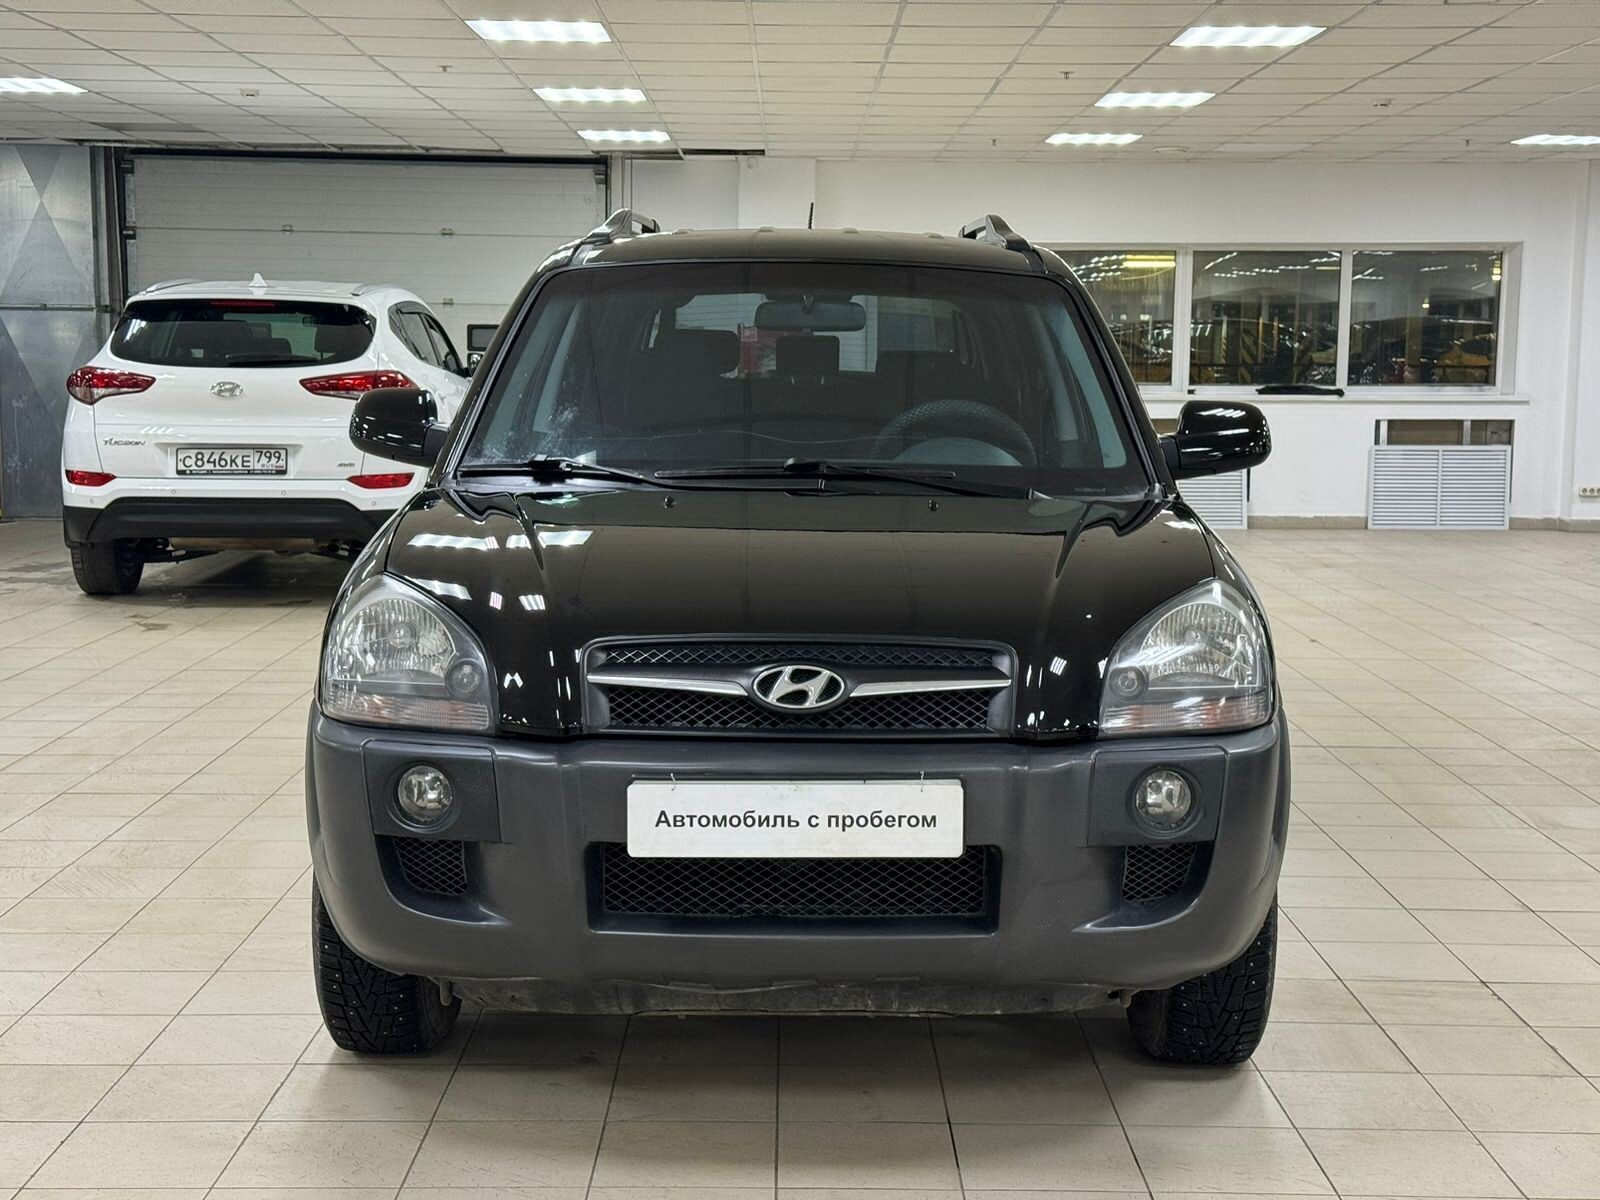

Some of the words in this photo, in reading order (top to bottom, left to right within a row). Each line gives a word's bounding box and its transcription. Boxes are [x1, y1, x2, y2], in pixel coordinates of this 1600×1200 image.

[182, 451, 251, 468] С846КЕ
[255, 450, 282, 464] 799
[654, 810, 800, 828] Автомобиль
[807, 814, 819, 828] с
[827, 810, 937, 832] пробегом
